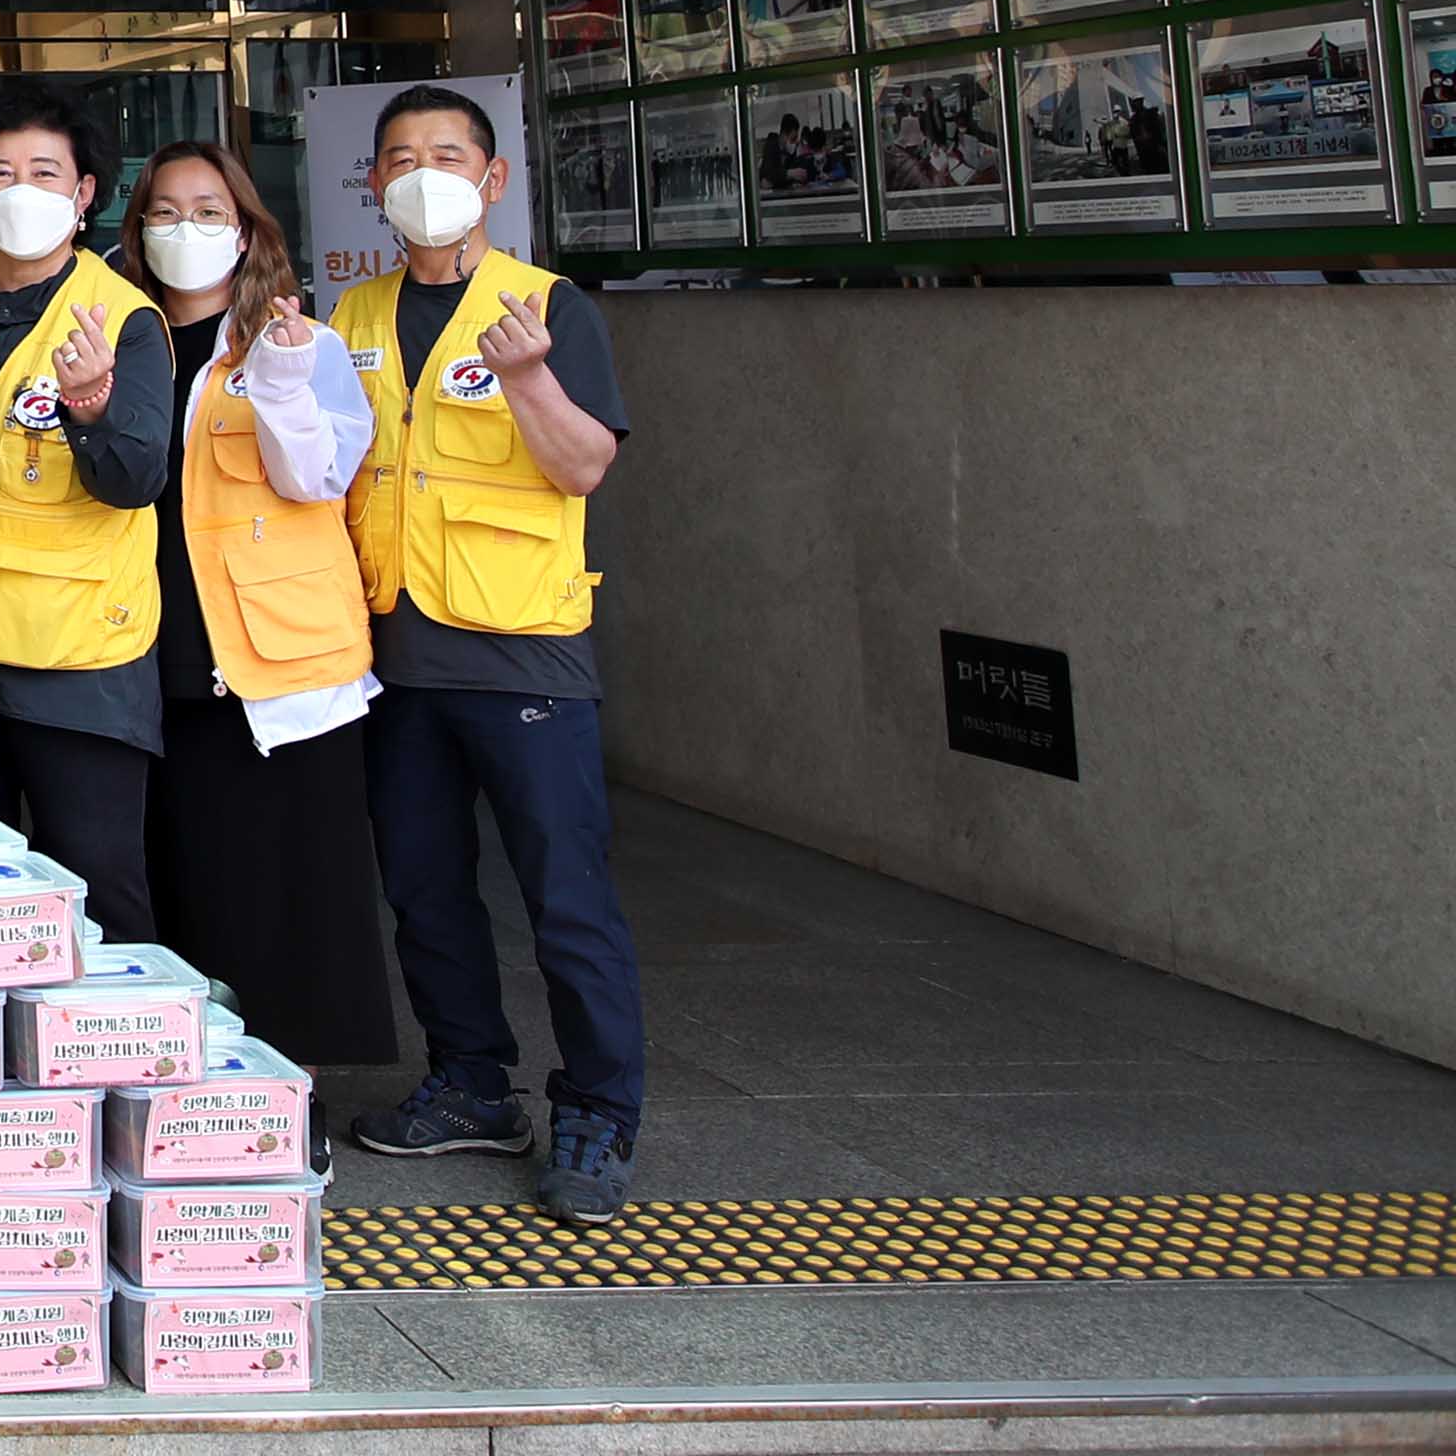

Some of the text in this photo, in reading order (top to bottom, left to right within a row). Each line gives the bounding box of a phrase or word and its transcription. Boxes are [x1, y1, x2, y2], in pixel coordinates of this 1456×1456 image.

[324, 249, 380, 282] 한시
[956, 659, 1054, 713] 머릿돌
[8, 901, 36, 917] 지원
[30, 922, 60, 939] 행사
[34, 1207, 63, 1222] 지원
[57, 1230, 88, 1246] 행사
